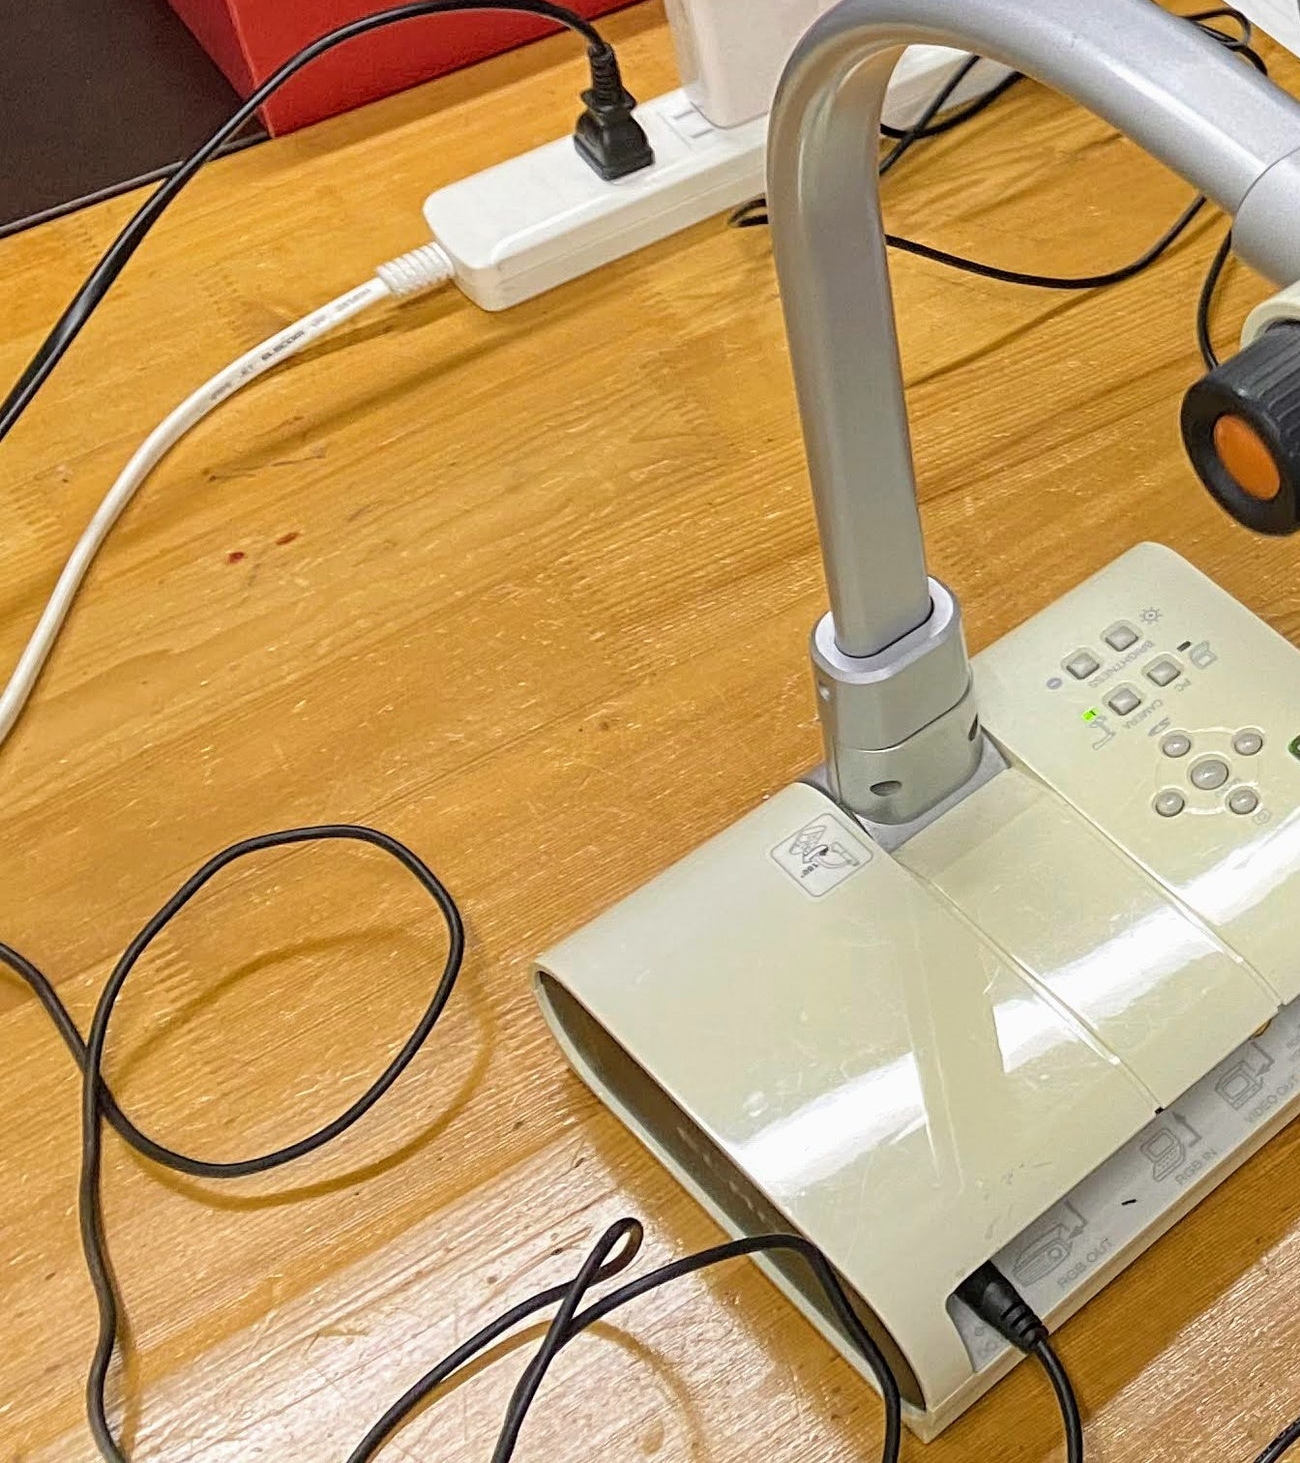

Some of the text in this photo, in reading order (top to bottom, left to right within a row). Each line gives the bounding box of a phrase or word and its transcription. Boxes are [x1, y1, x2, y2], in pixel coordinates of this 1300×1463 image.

[1088, 640, 1156, 689] BRIGHTNESS
[1123, 698, 1163, 730] CAMERA
[1243, 1073, 1300, 1124] VIDEO OUT
[1174, 1147, 1218, 1186] RGB IN
[1056, 1237, 1114, 1288] RGB OUT
